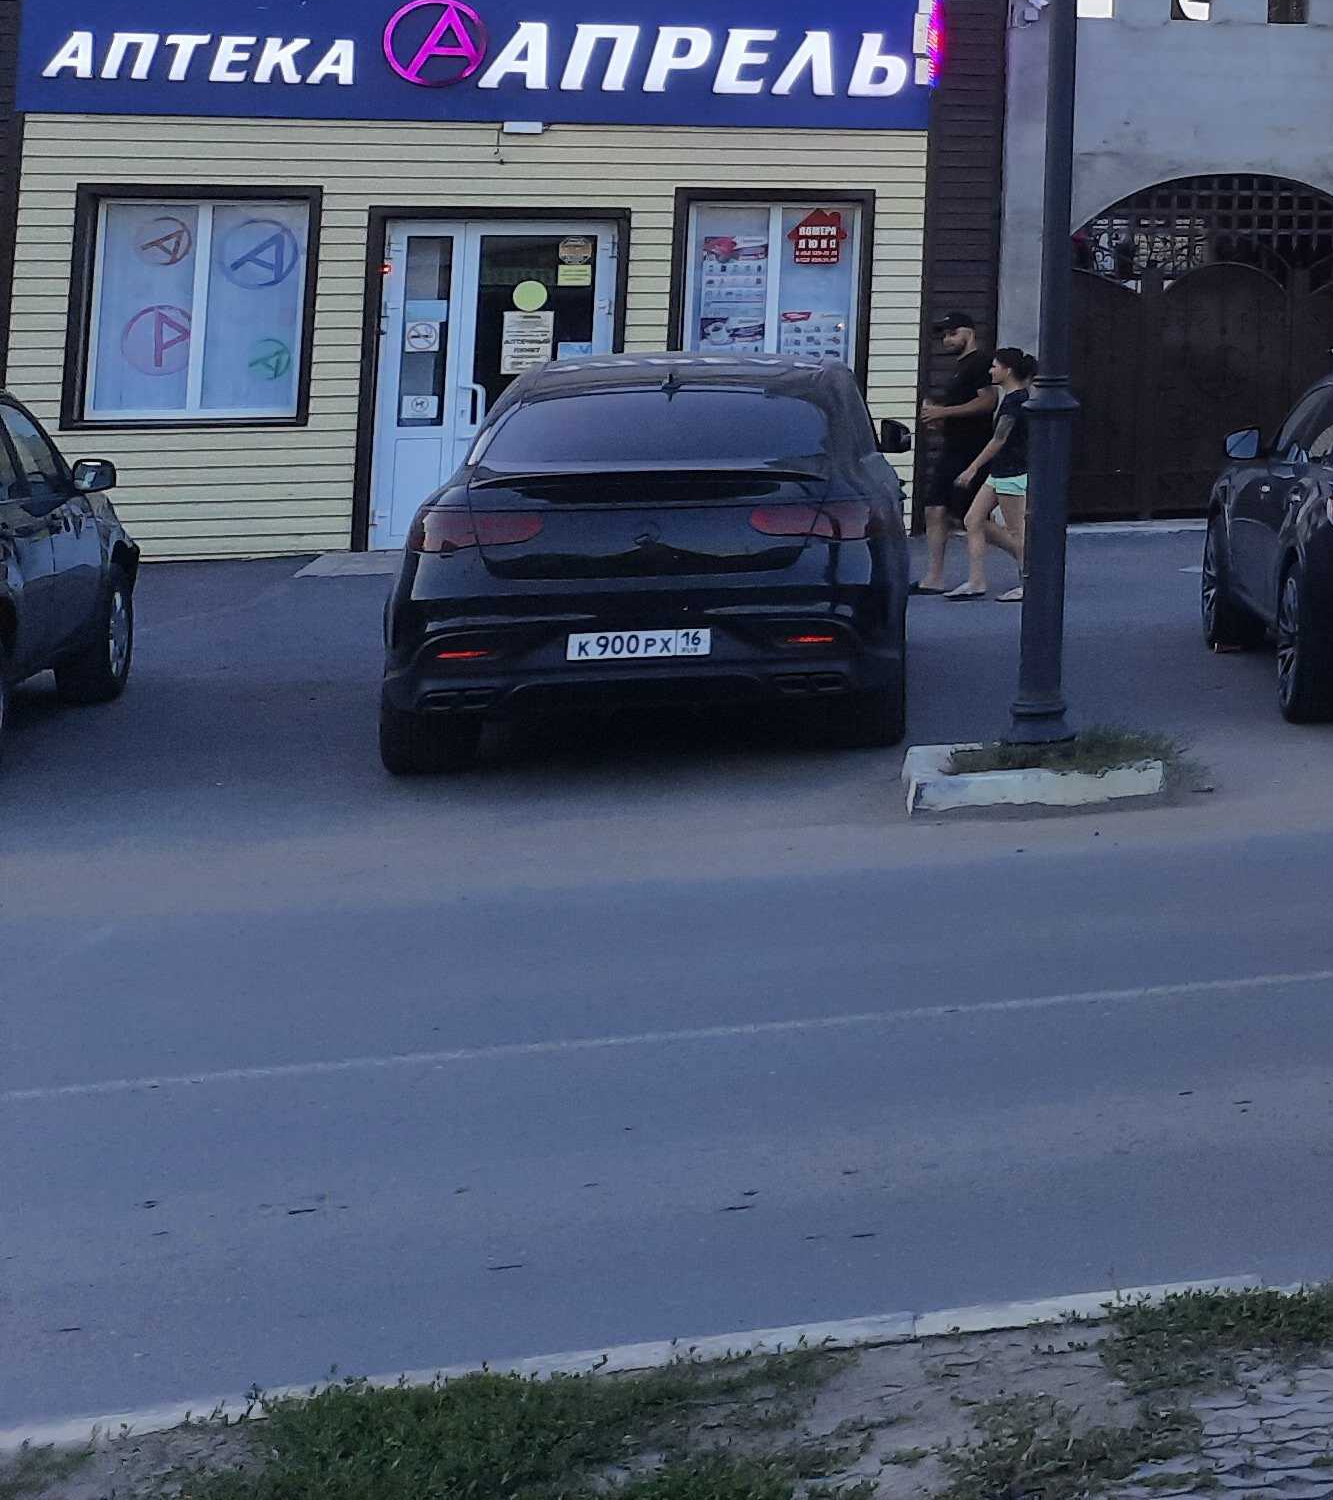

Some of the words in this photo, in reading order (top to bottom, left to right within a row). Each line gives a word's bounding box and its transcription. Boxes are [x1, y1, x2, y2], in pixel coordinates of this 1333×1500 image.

[42, 30, 356, 86] АПТЕКА
[475, 21, 908, 98] АПРЕЛЬ
[577, 634, 672, 657] К900РХ
[680, 630, 701, 647] 16
